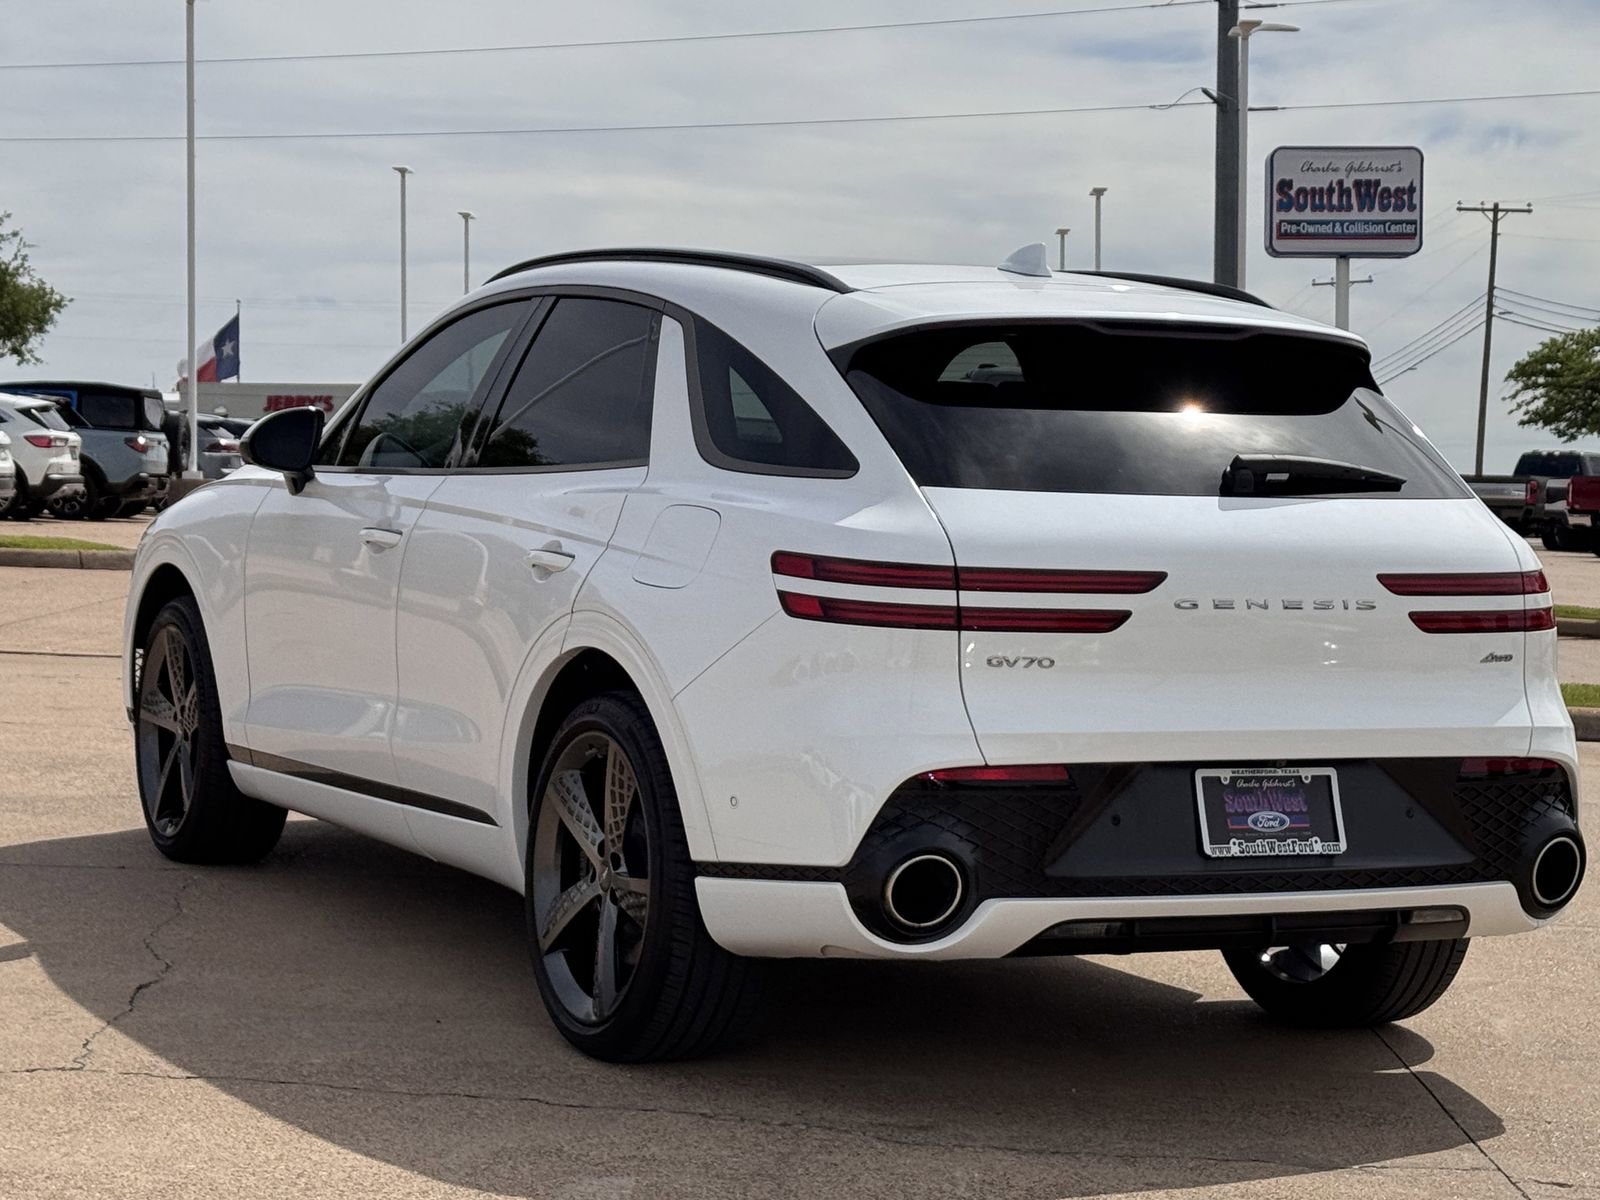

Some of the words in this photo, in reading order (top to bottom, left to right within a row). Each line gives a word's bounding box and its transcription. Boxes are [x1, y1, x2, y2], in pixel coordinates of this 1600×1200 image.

[1276, 178, 1417, 213] SouthWest
[1281, 222, 1333, 234] Pre-Owned
[1334, 222, 1342, 233] &
[1343, 222, 1385, 234] Collision
[1386, 222, 1416, 234] Center
[1173, 599, 1377, 610] GENESIS
[986, 655, 1056, 669] GV70
[1257, 815, 1281, 828] Ford
